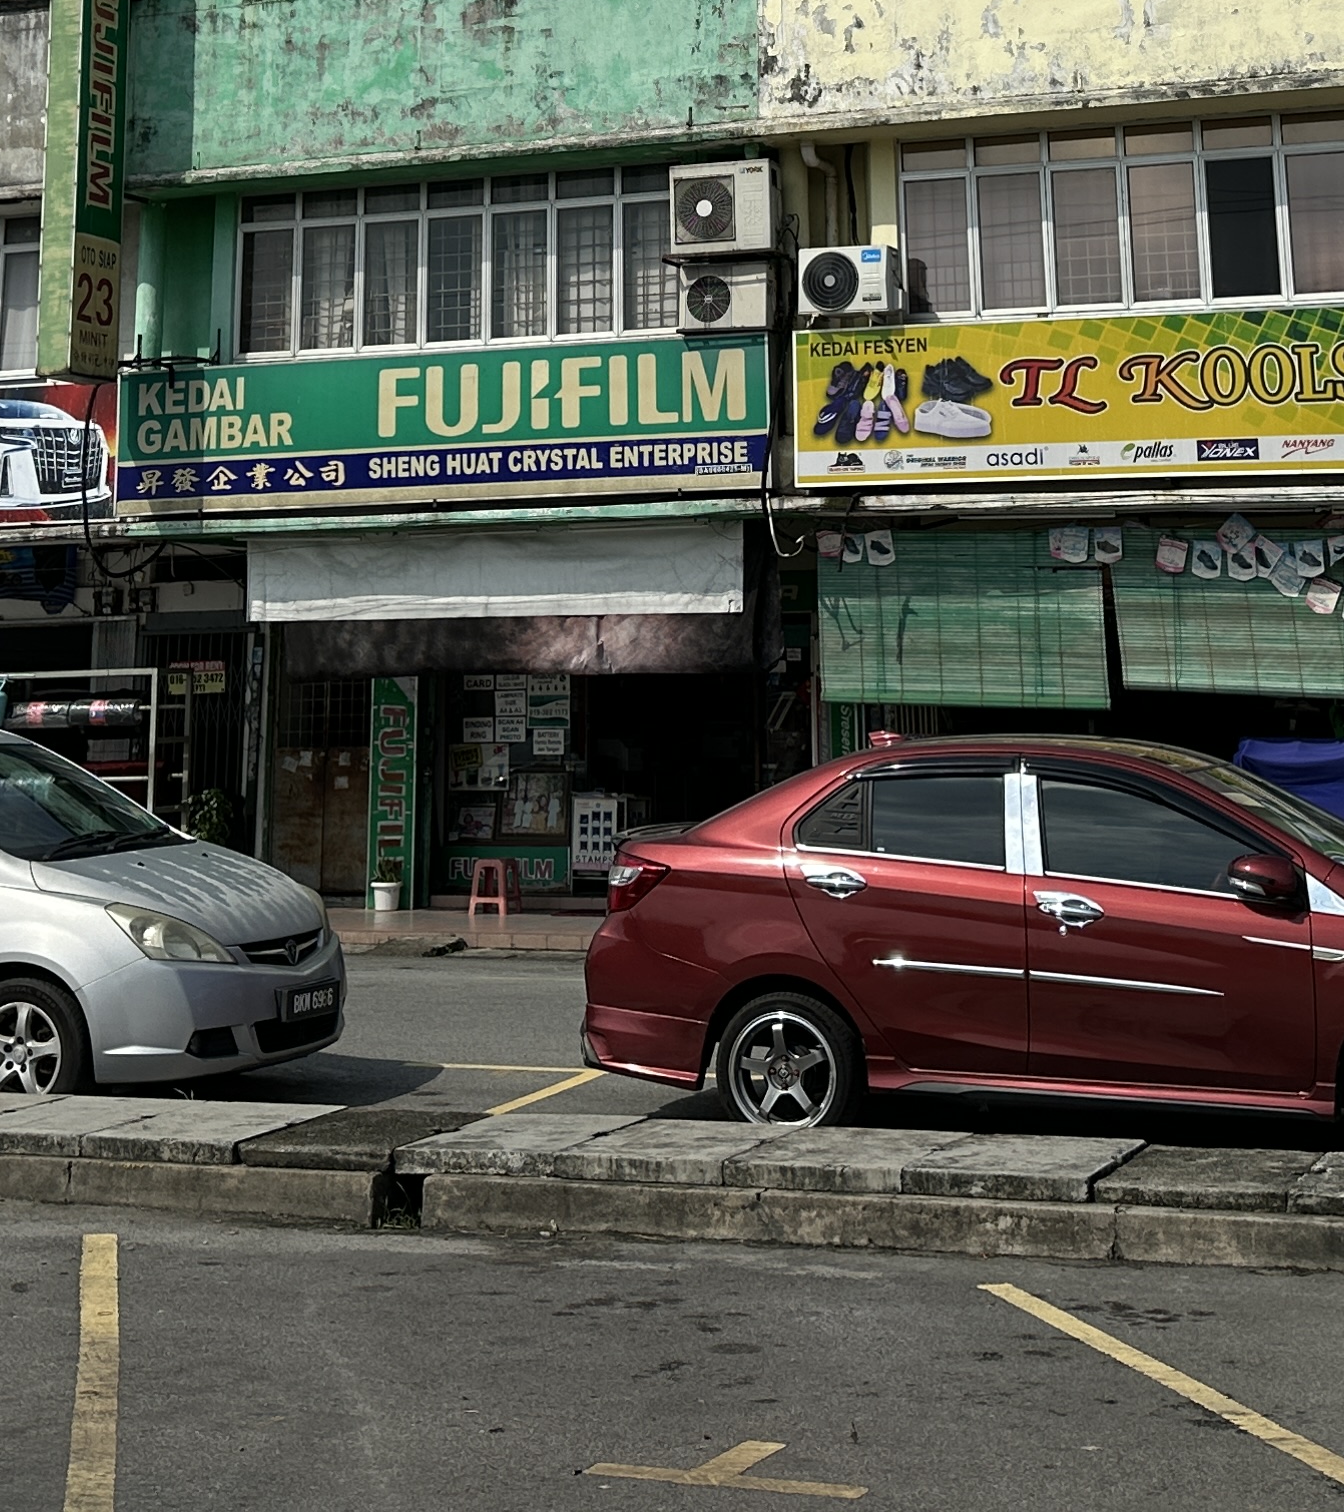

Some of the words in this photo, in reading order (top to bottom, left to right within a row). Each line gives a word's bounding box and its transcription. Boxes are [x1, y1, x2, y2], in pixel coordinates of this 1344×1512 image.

[76, 272, 114, 326] 23
[79, 329, 108, 349] MINIT
[809, 340, 861, 359] KEDAI
[863, 337, 929, 356] FESYEN
[137, 376, 245, 417] KEDAI
[377, 348, 748, 439] FUJIFILM
[999, 355, 1108, 416] TL
[137, 413, 293, 455] GAMBAR
[1282, 438, 1336, 450] NANYANG
[367, 453, 440, 481] SHENG
[445, 450, 504, 477] HUAT
[508, 445, 605, 473] CRYSTAL
[609, 440, 749, 470] ENTERPRISE
[986, 448, 1044, 468] asadi
[1201, 443, 1257, 459] YONEX
[466, 679, 492, 688] CARD
[470, 731, 487, 739] RING
